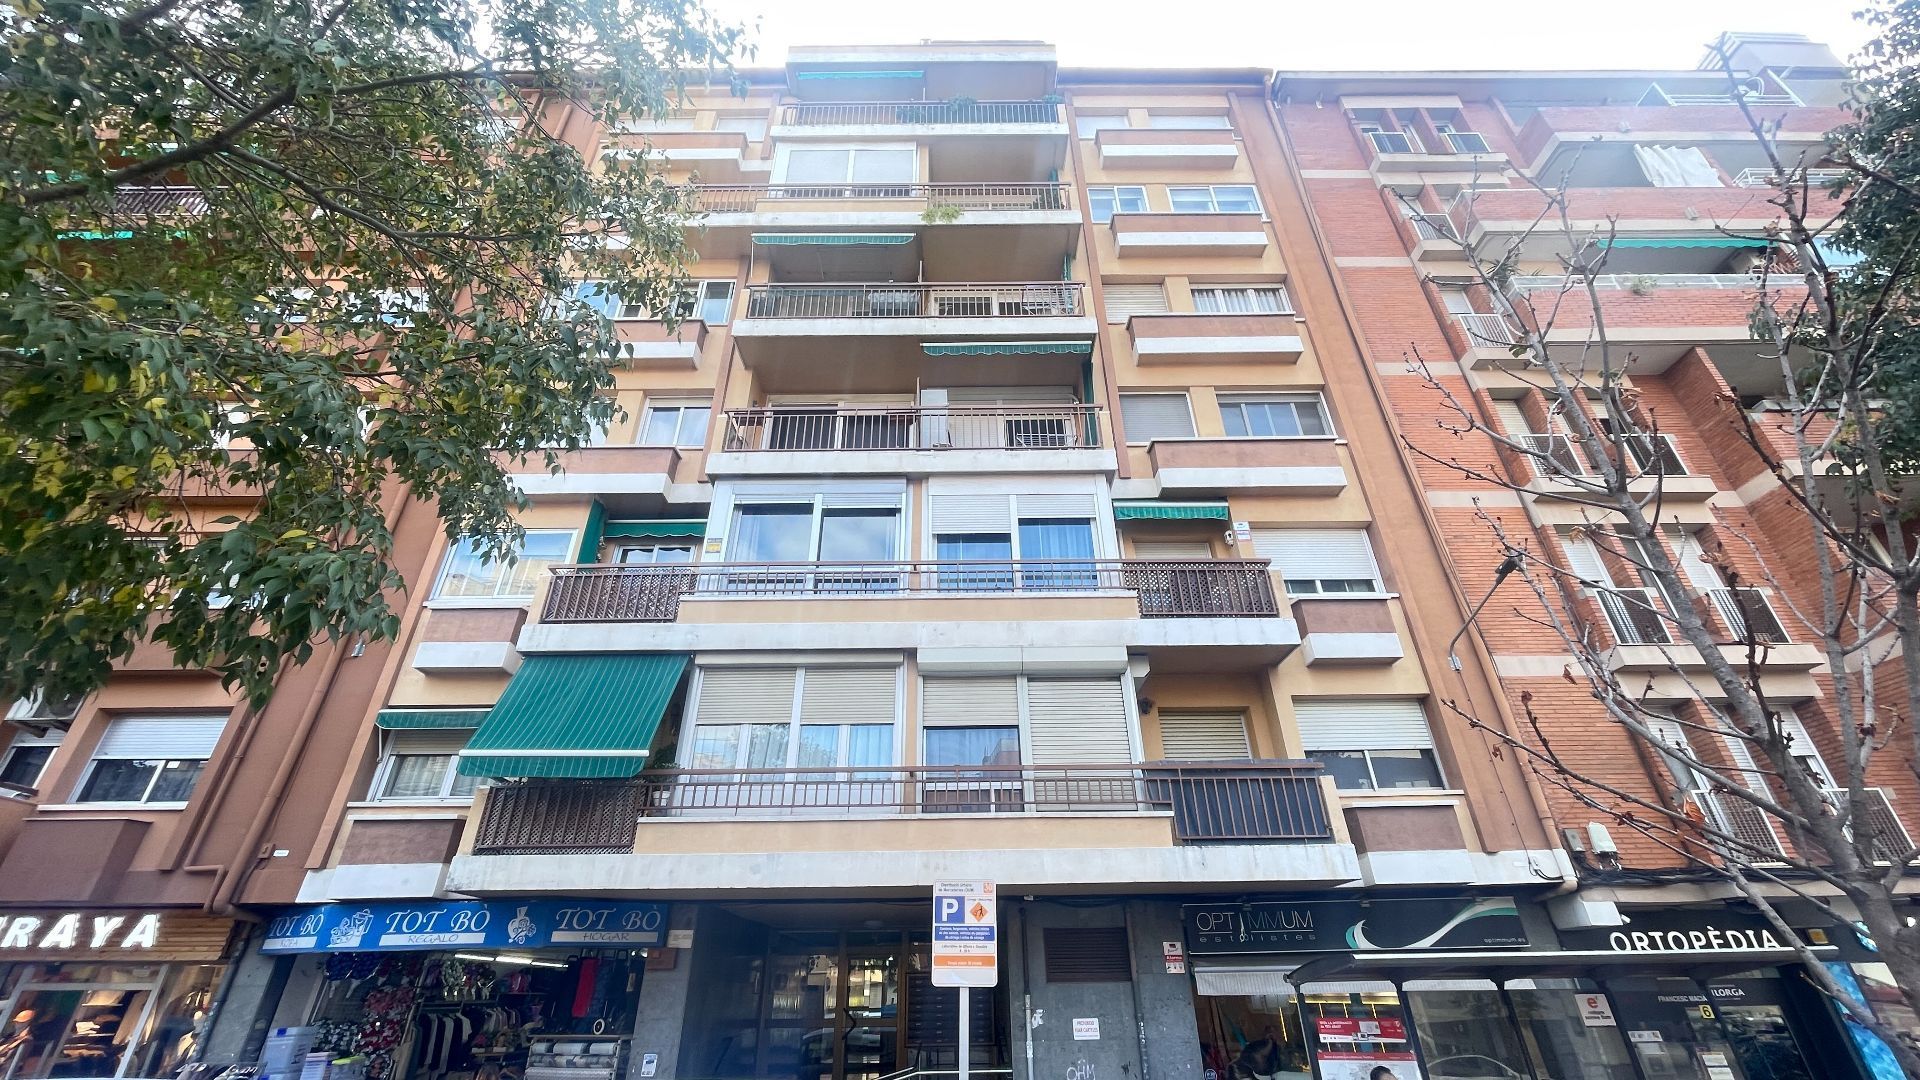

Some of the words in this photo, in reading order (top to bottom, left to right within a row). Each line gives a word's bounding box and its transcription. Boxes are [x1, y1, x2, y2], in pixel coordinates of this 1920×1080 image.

[386, 909, 447, 933] TOT
[450, 904, 491, 932] BÒ
[556, 907, 617, 930] TOT
[622, 904, 661, 931] BÒ
[942, 898, 959, 922] P
[269, 914, 302, 937] TOT
[582, 932, 630, 942] HOGAR
[408, 934, 459, 944] REGALO
[1609, 925, 1783, 951] ORTOPÈDIA
[1702, 1006, 1712, 1017] 6
